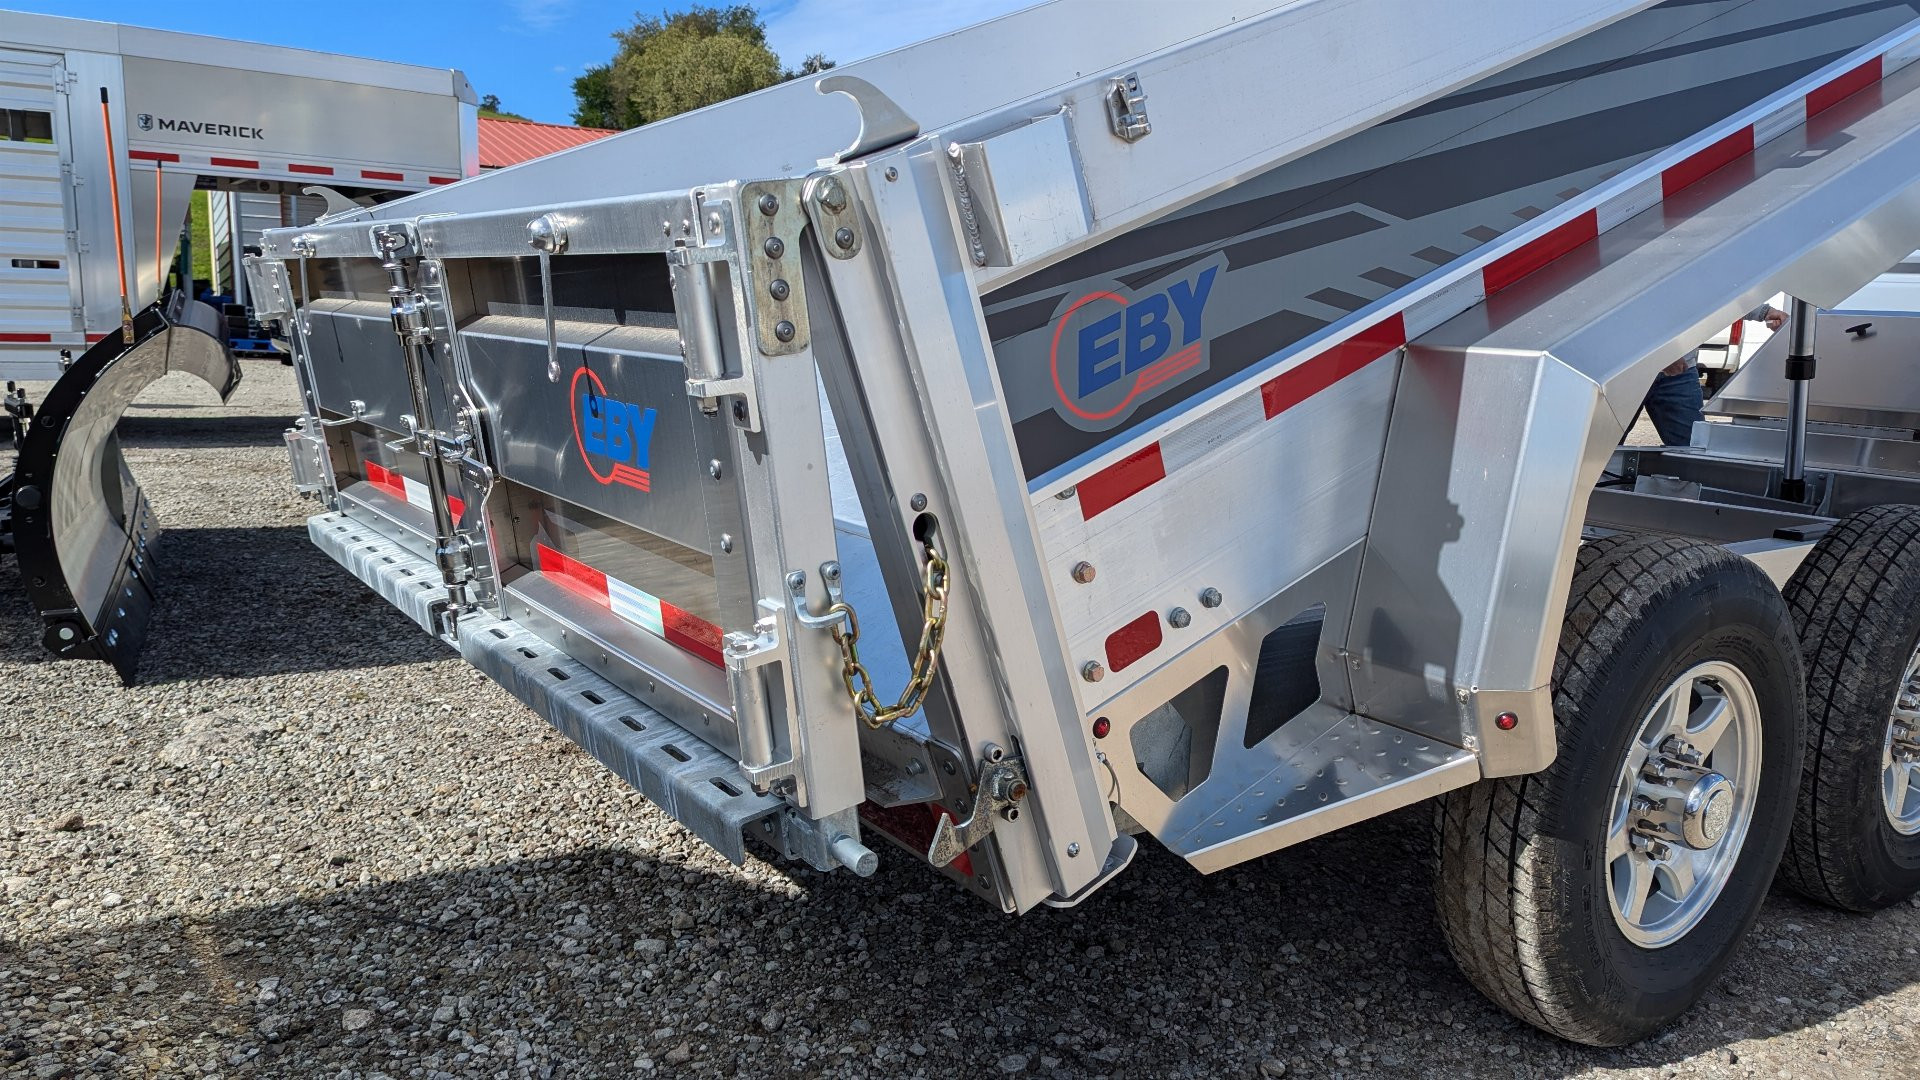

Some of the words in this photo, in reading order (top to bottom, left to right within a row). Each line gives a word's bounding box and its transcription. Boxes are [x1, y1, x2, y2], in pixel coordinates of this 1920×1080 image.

[158, 118, 264, 140] MAVERICK
[1078, 264, 1219, 400] EBY
[583, 393, 657, 470] EBY
